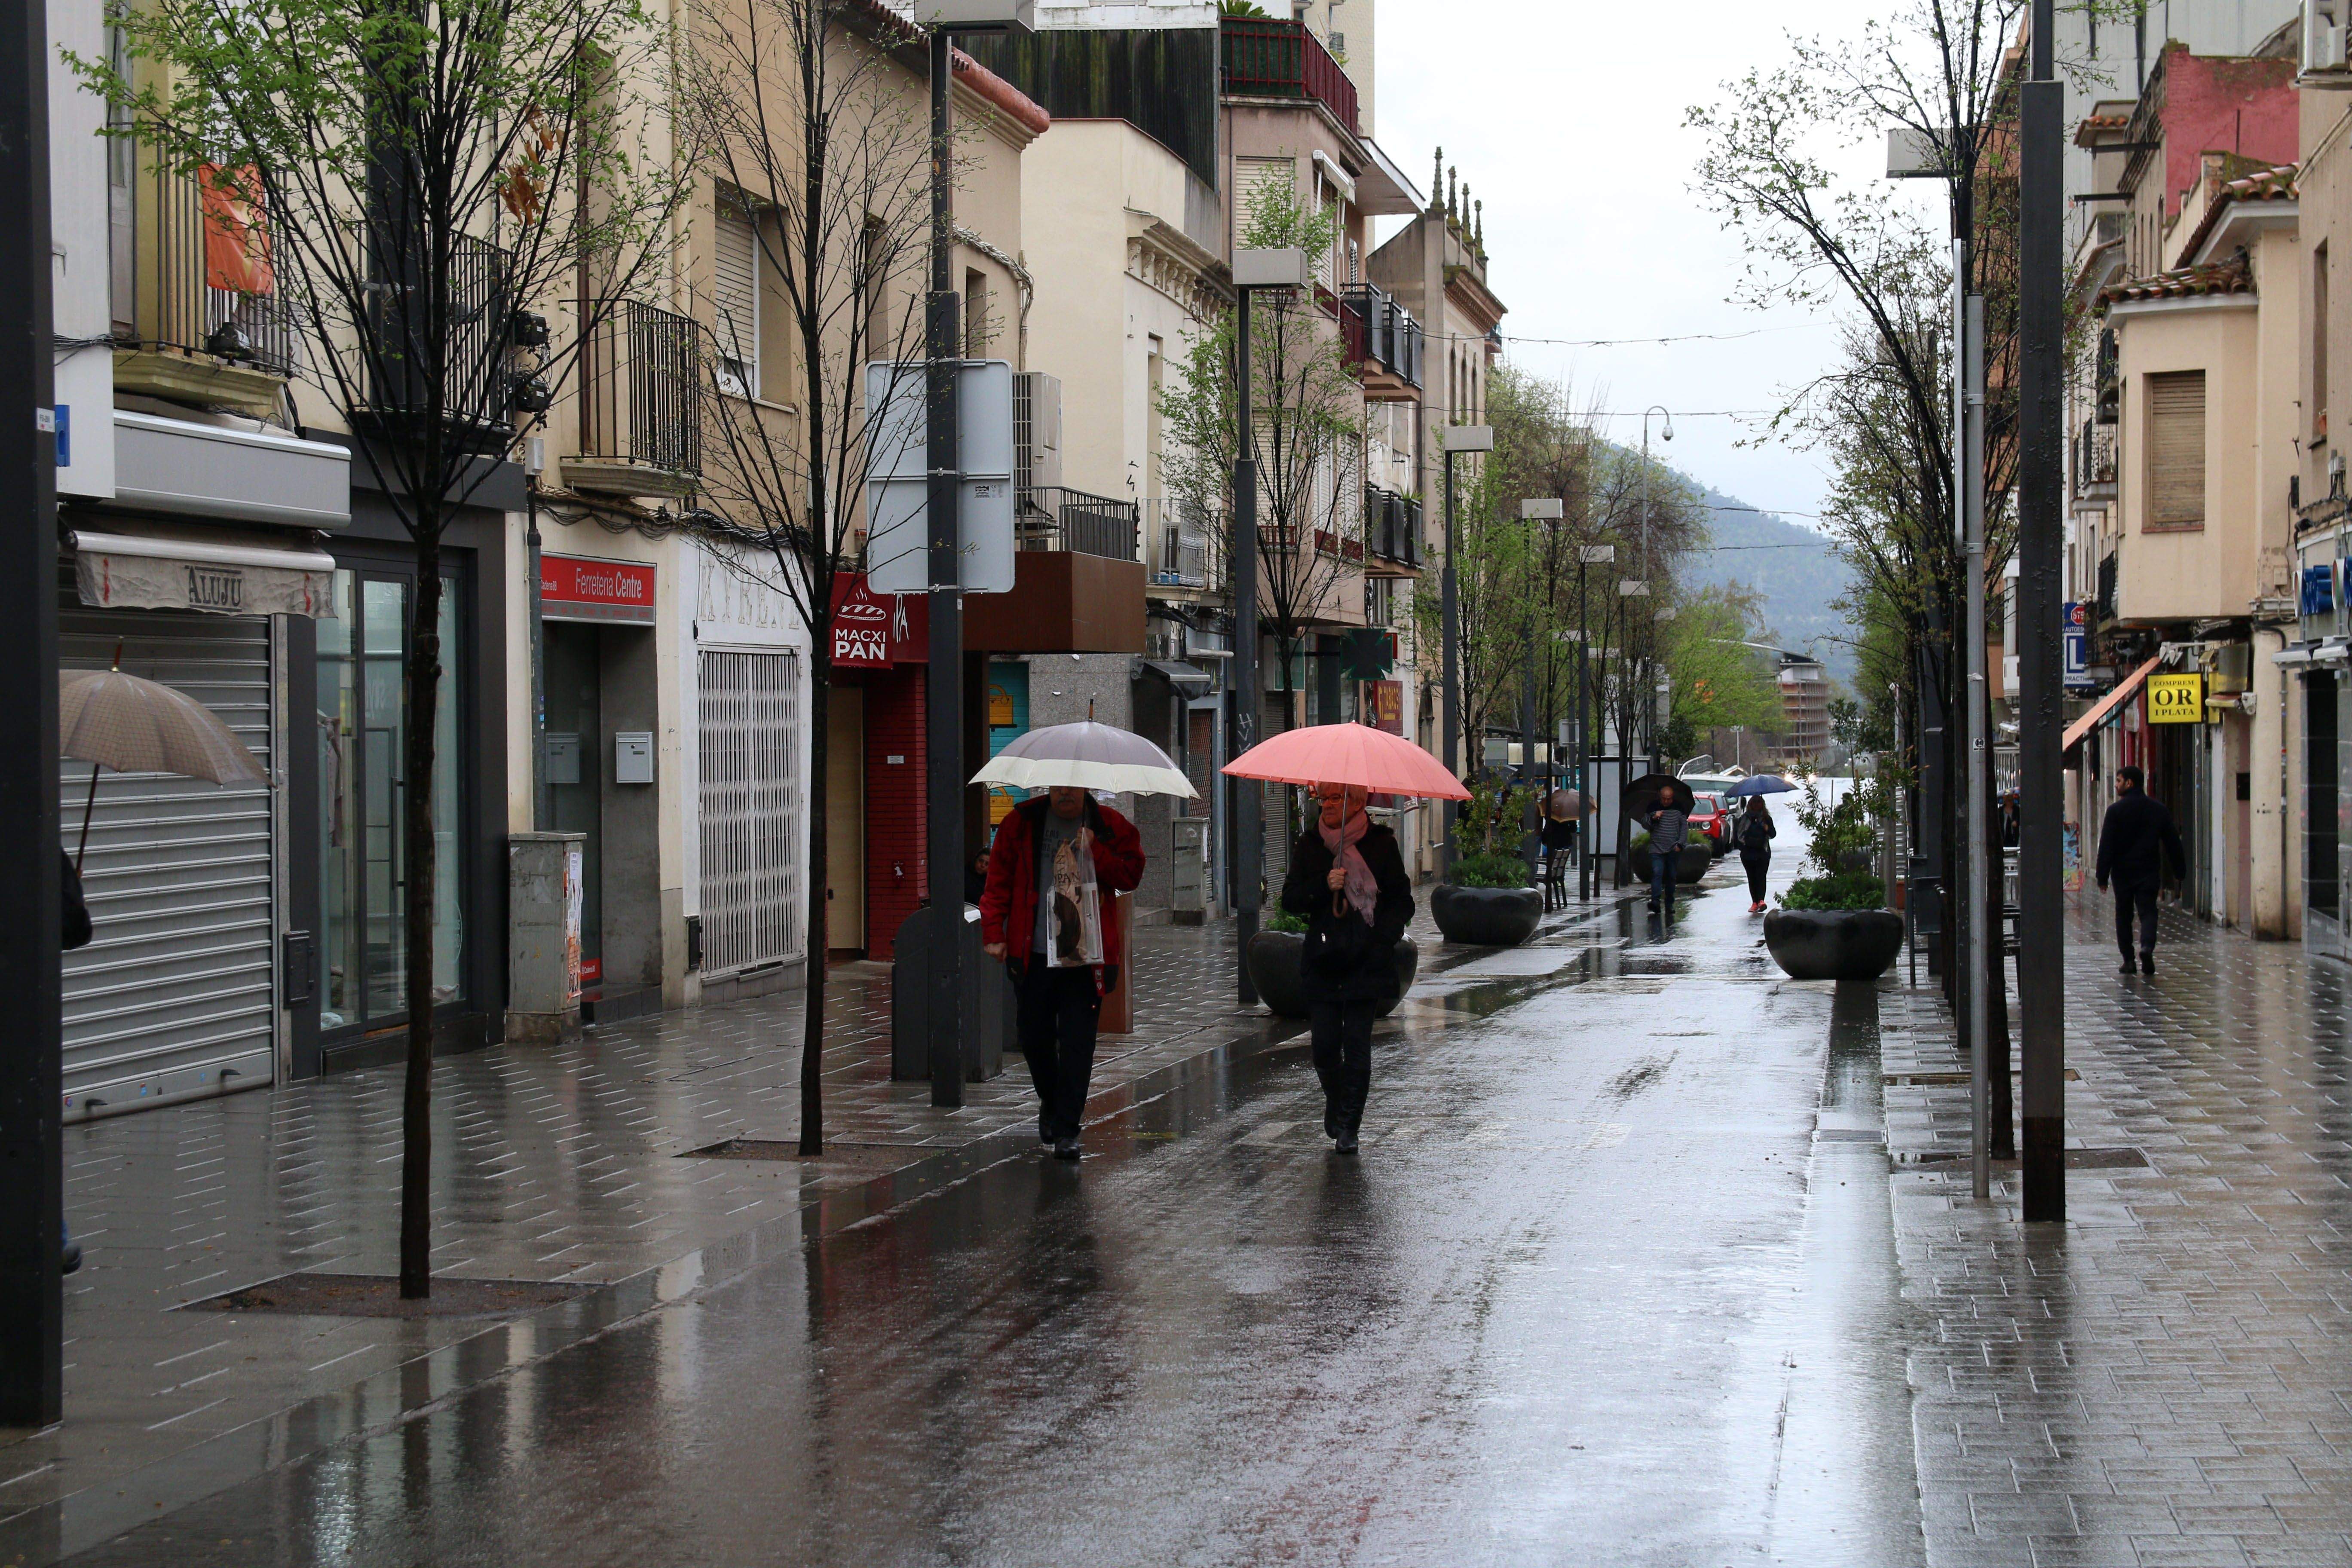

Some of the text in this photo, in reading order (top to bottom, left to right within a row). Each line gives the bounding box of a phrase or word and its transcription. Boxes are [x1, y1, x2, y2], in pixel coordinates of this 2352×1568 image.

[189, 566, 242, 606] ALUJU
[576, 567, 642, 599] Ferreteria Centre
[836, 628, 886, 643] MACXI
[836, 641, 885, 660] PAN
[2155, 689, 2194, 706] OR
[2162, 708, 2195, 716] PLATA
